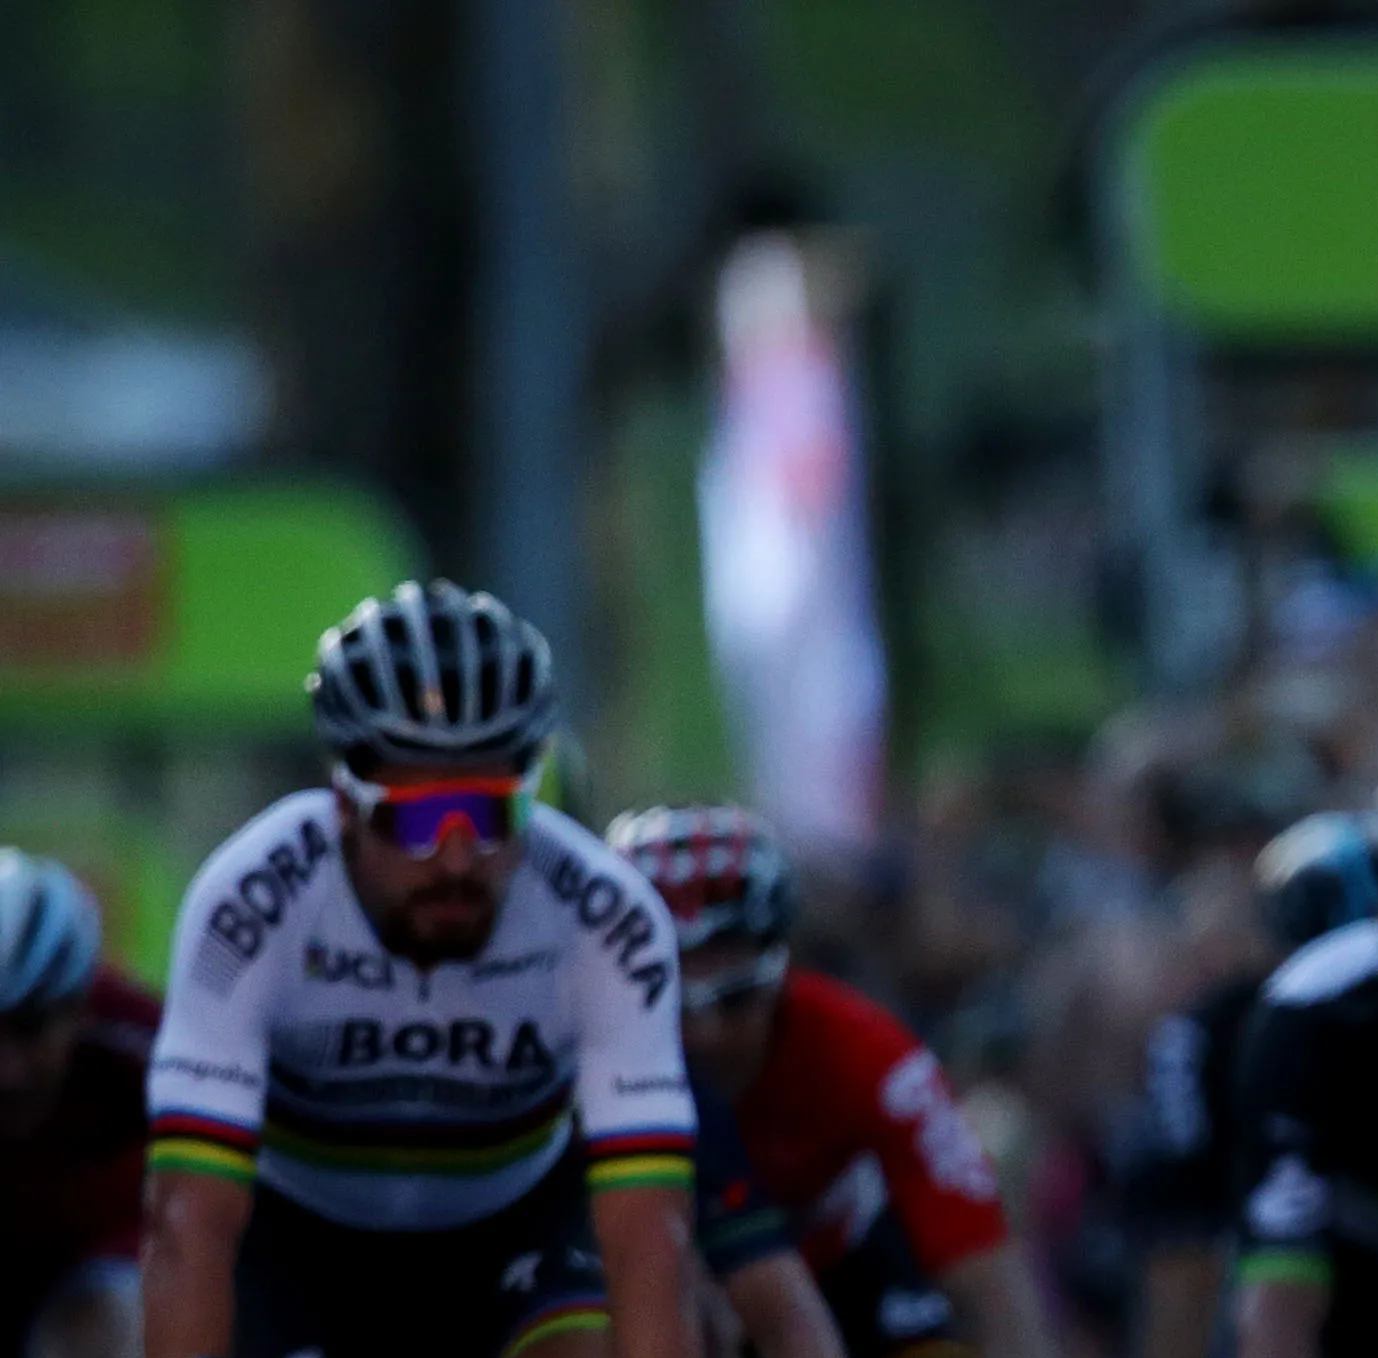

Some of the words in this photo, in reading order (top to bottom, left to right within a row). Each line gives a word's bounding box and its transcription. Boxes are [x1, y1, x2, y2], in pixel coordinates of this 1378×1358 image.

[209, 818, 329, 959] BORA
[549, 852, 674, 1010] BORA
[337, 1017, 556, 1074] BORA
